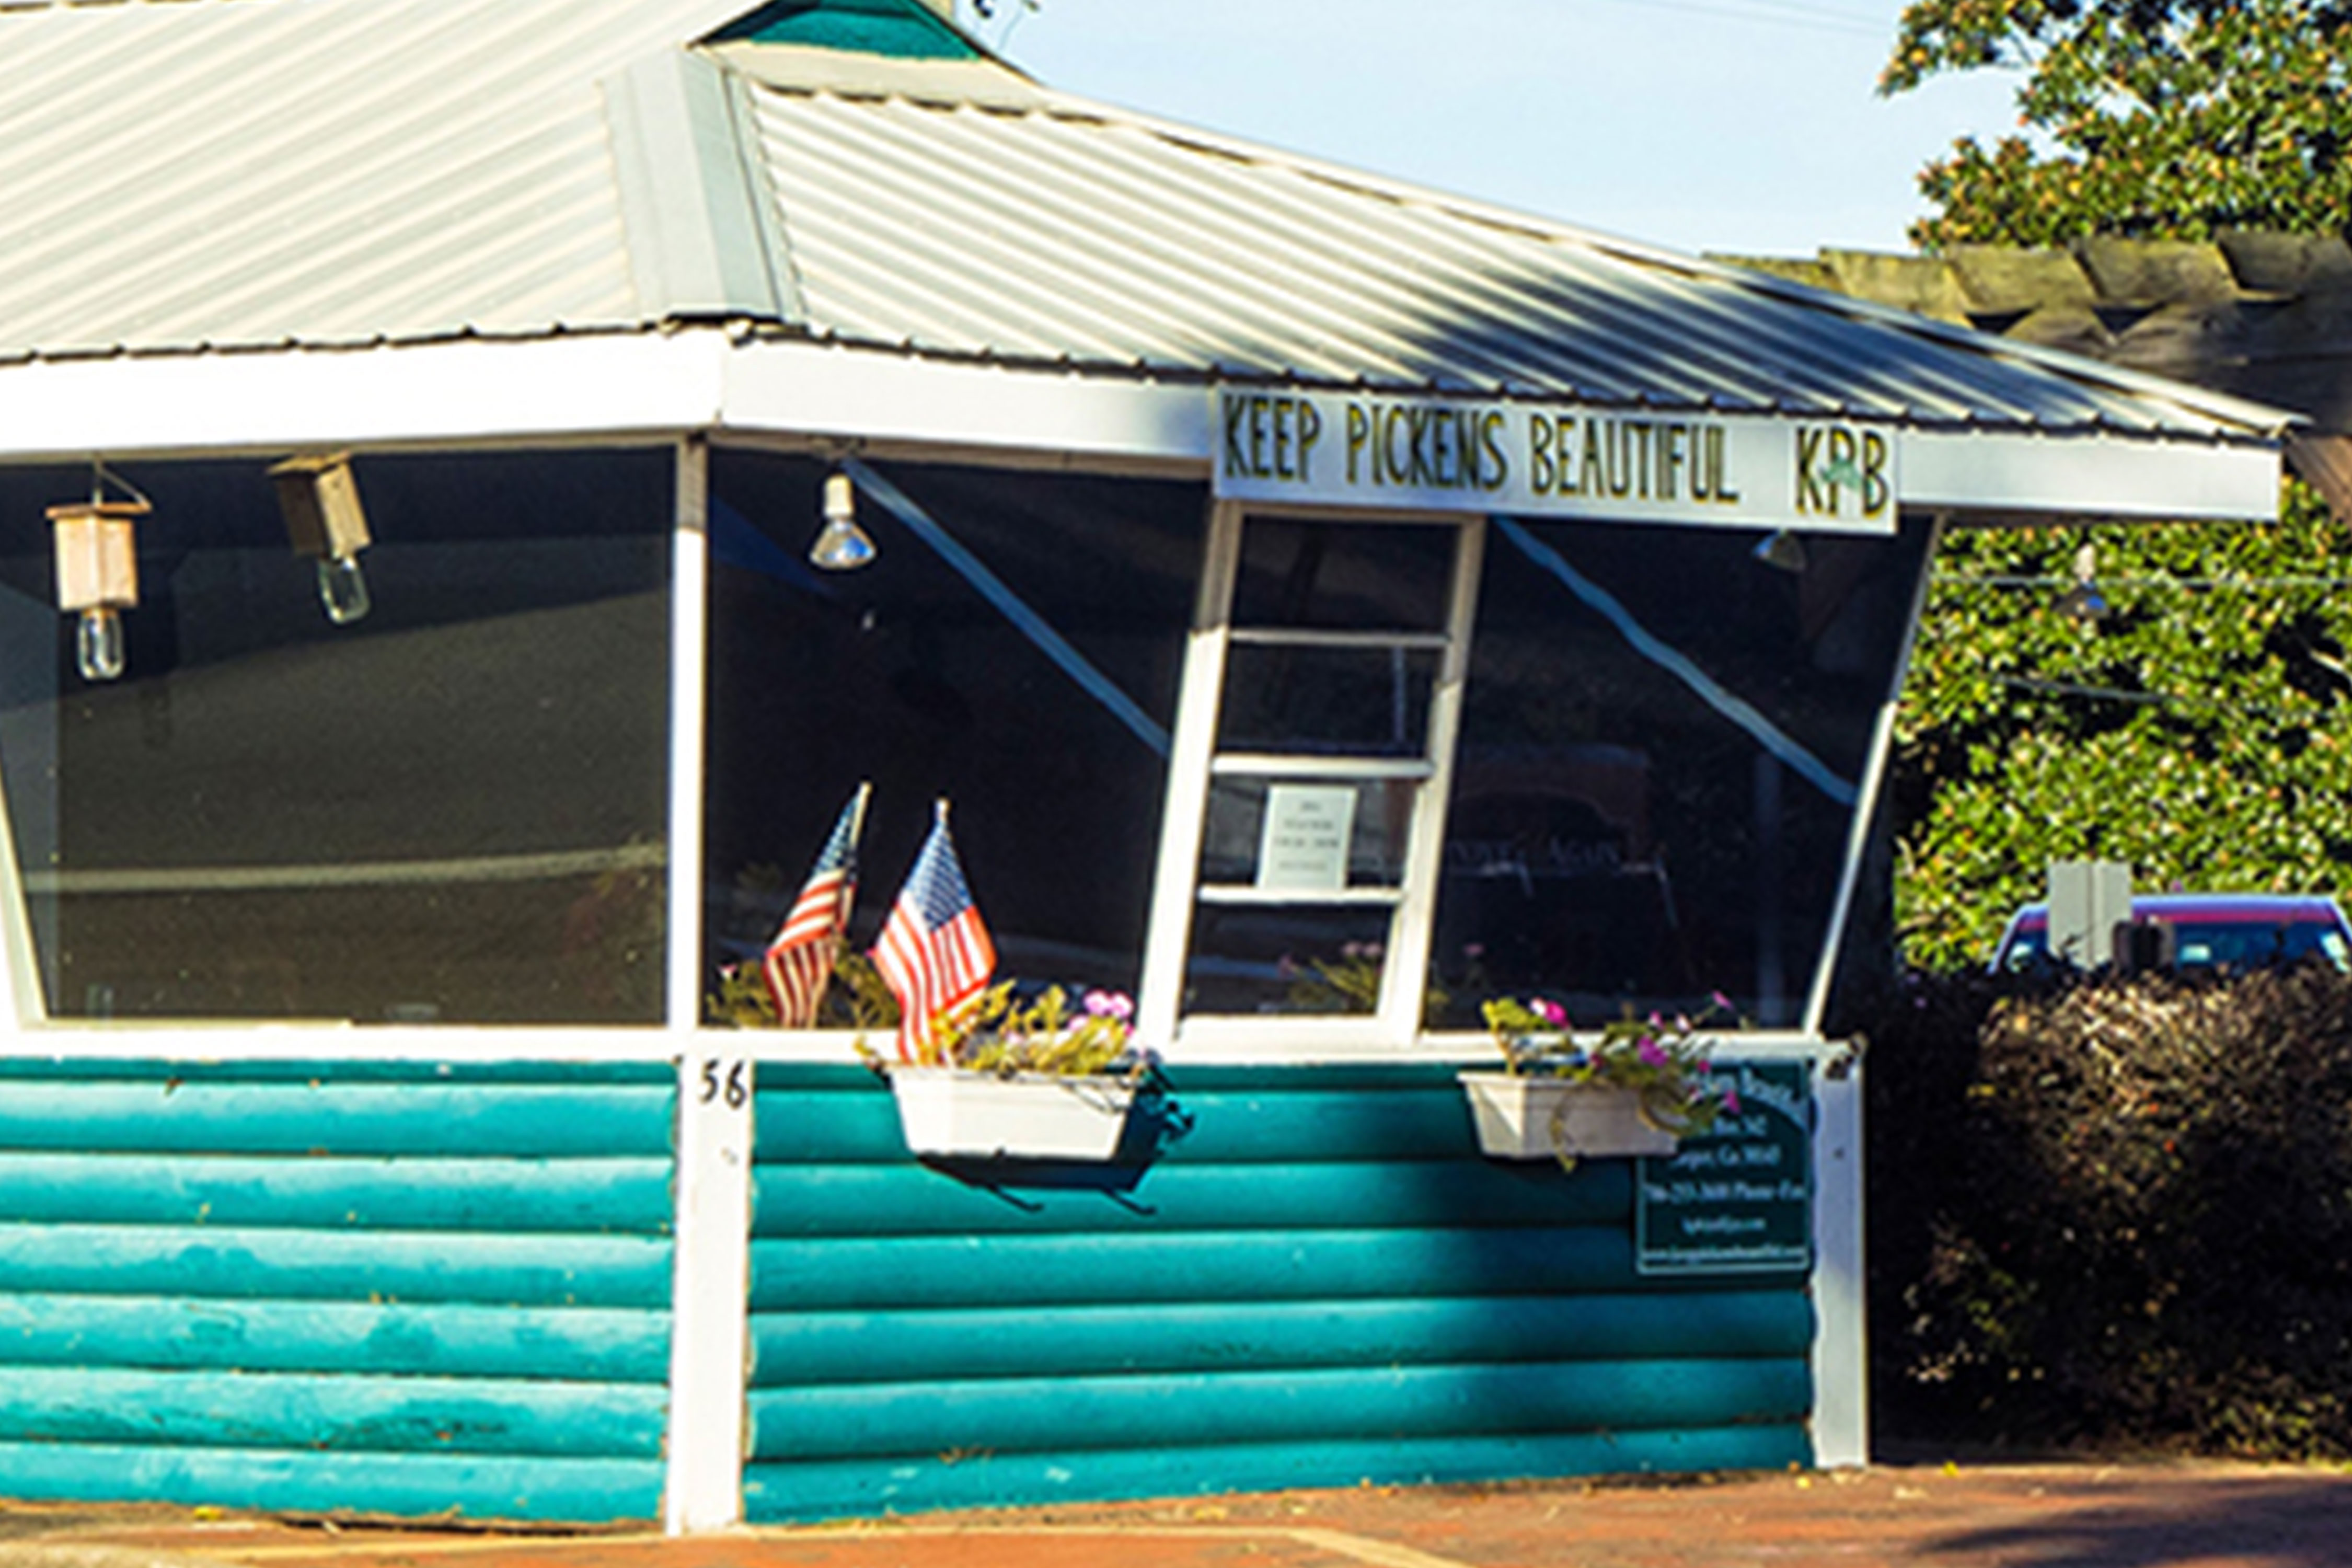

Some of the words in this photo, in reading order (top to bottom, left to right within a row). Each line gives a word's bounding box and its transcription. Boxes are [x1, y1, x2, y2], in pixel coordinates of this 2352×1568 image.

[1223, 393, 1321, 484] KEEP
[1346, 401, 1509, 492] PICKENS
[1529, 412, 1739, 504] BEAUTIFUL
[1795, 424, 1889, 520] KPB
[698, 1058, 746, 1110] 56
